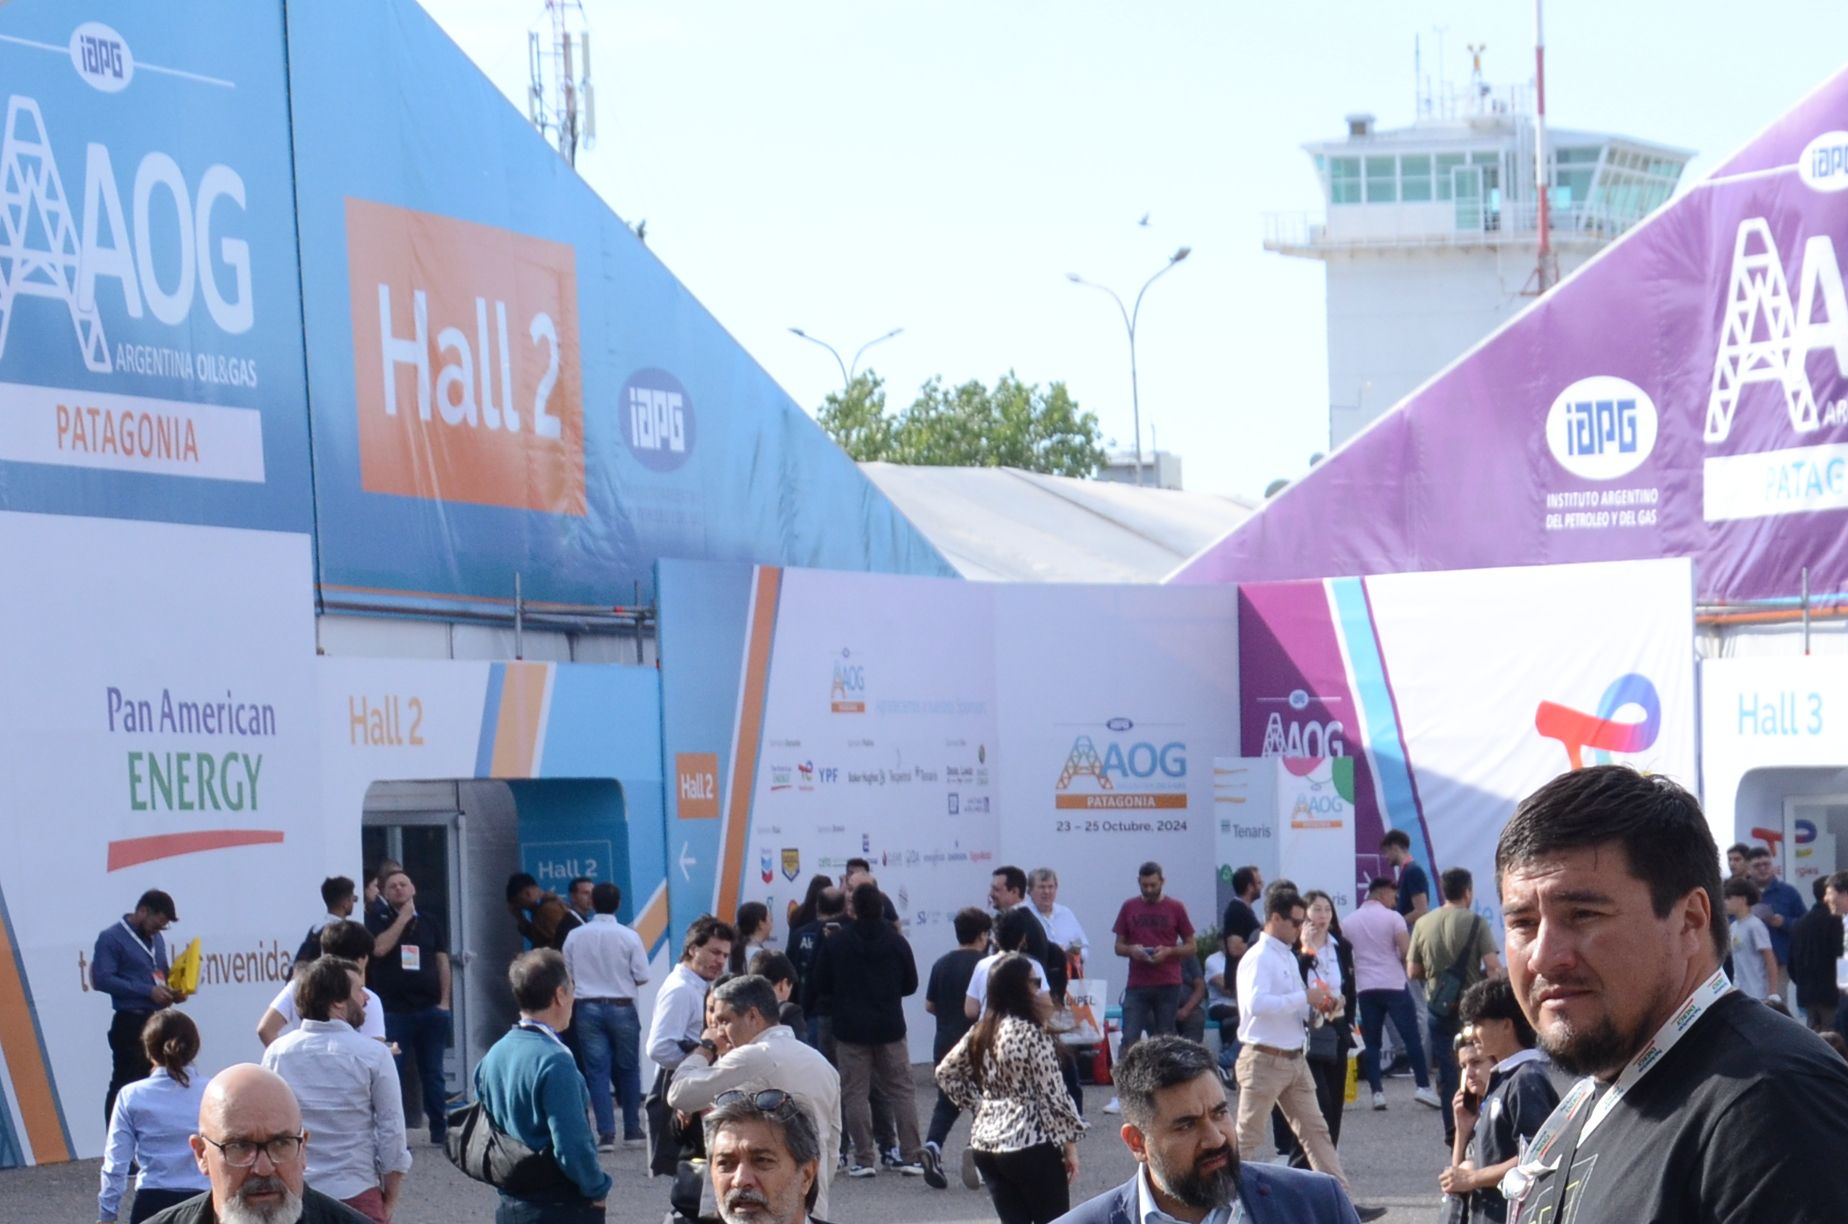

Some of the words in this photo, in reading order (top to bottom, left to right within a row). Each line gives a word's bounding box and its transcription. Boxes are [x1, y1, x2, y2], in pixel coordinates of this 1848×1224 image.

[116, 343, 193, 381] ARGENTINA
[196, 353, 257, 388] OIL&GAS
[378, 283, 519, 433] Hall
[528, 312, 562, 441] 2
[56, 404, 199, 462] PATAGONIA
[1546, 490, 1600, 508] INSTITUTO
[1600, 487, 1659, 506] ARGENTINO
[1546, 513, 1563, 529] DEL
[1564, 511, 1610, 528] PETROLEO
[1611, 511, 1618, 526] Y
[1619, 510, 1636, 526] DEL
[1637, 508, 1657, 526] GAS
[106, 686, 153, 733] Pan
[159, 688, 277, 737] American
[349, 694, 404, 747] Hall
[408, 697, 424, 745] 2
[1738, 691, 1799, 736] Hall
[1807, 691, 1824, 736] 3
[127, 750, 263, 812] ENERGY
[680, 774, 704, 800] Hall
[704, 775, 715, 799] 2
[818, 767, 839, 784] YPF
[1087, 796, 1156, 808] PATAGONIA
[1056, 820, 1072, 832] 23
[1085, 821, 1100, 832] 25
[1102, 820, 1153, 833] Octubre,
[1156, 820, 1188, 832] 2024
[1232, 823, 1272, 839] Tenaris
[538, 859, 580, 879] Hall
[584, 859, 598, 878] 2
